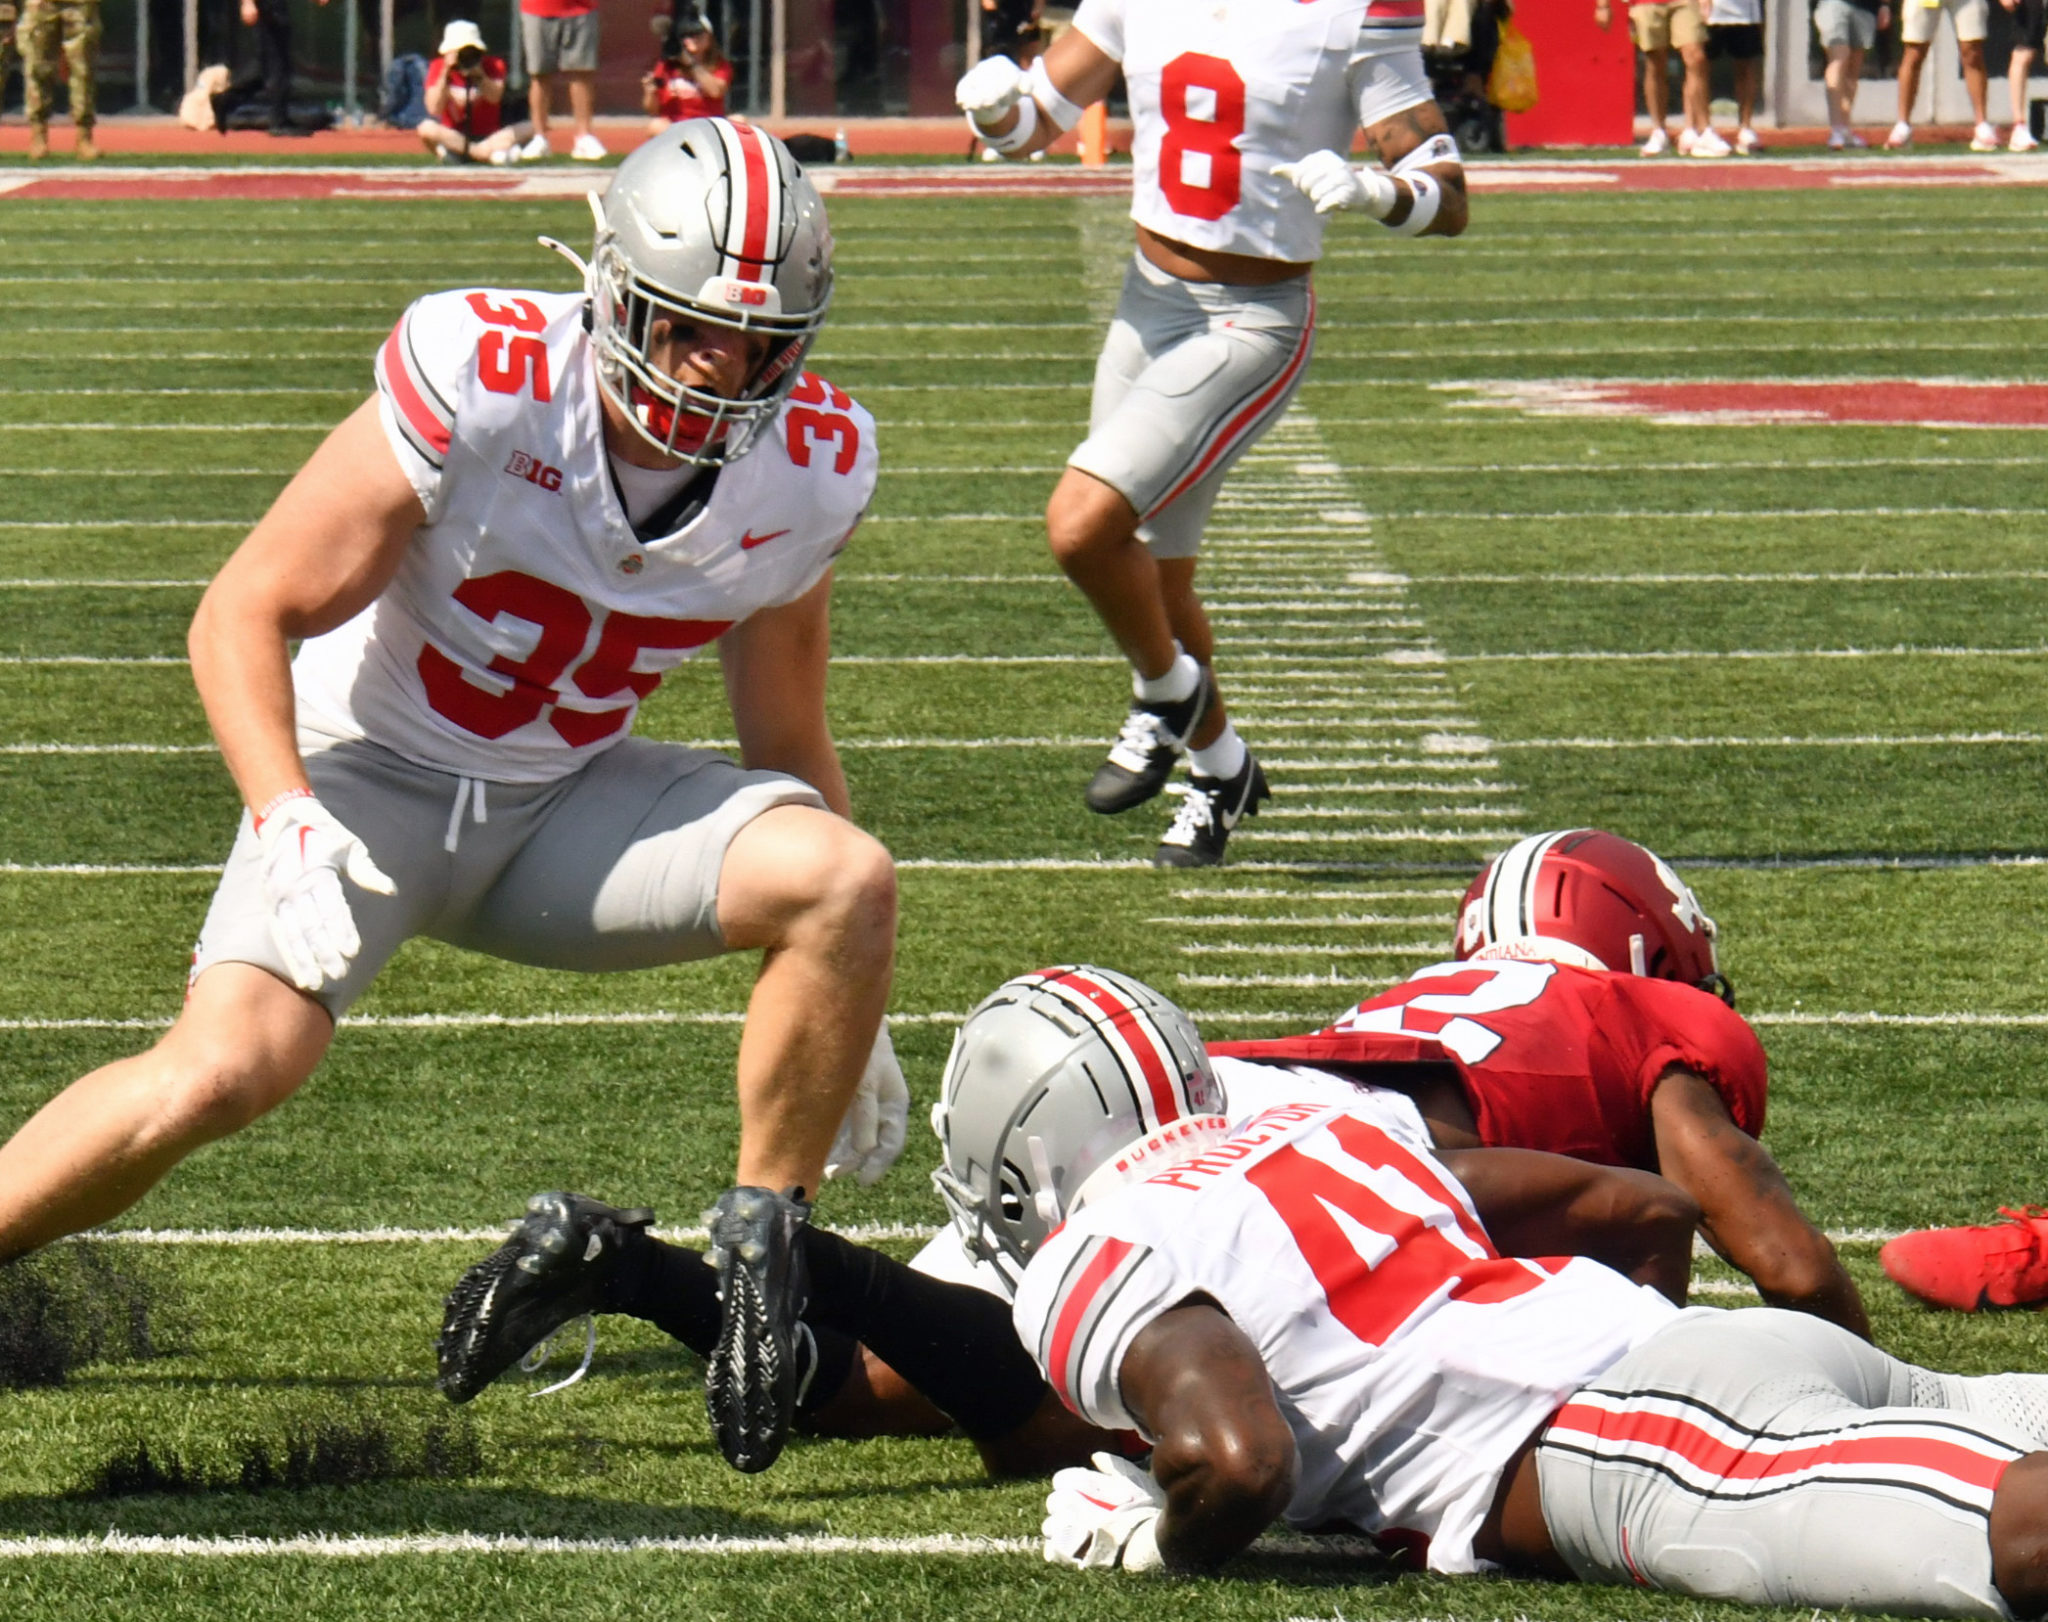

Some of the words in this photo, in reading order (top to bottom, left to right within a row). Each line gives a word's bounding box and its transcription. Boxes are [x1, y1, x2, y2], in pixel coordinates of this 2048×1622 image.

[1159, 51, 1246, 222] 8
[465, 292, 552, 403] 35
[417, 570, 736, 749] 35
[1115, 1117, 1227, 1173] BUCKEYES
[1145, 1103, 1329, 1192] PROCTOR
[1244, 1113, 1574, 1347] 41
